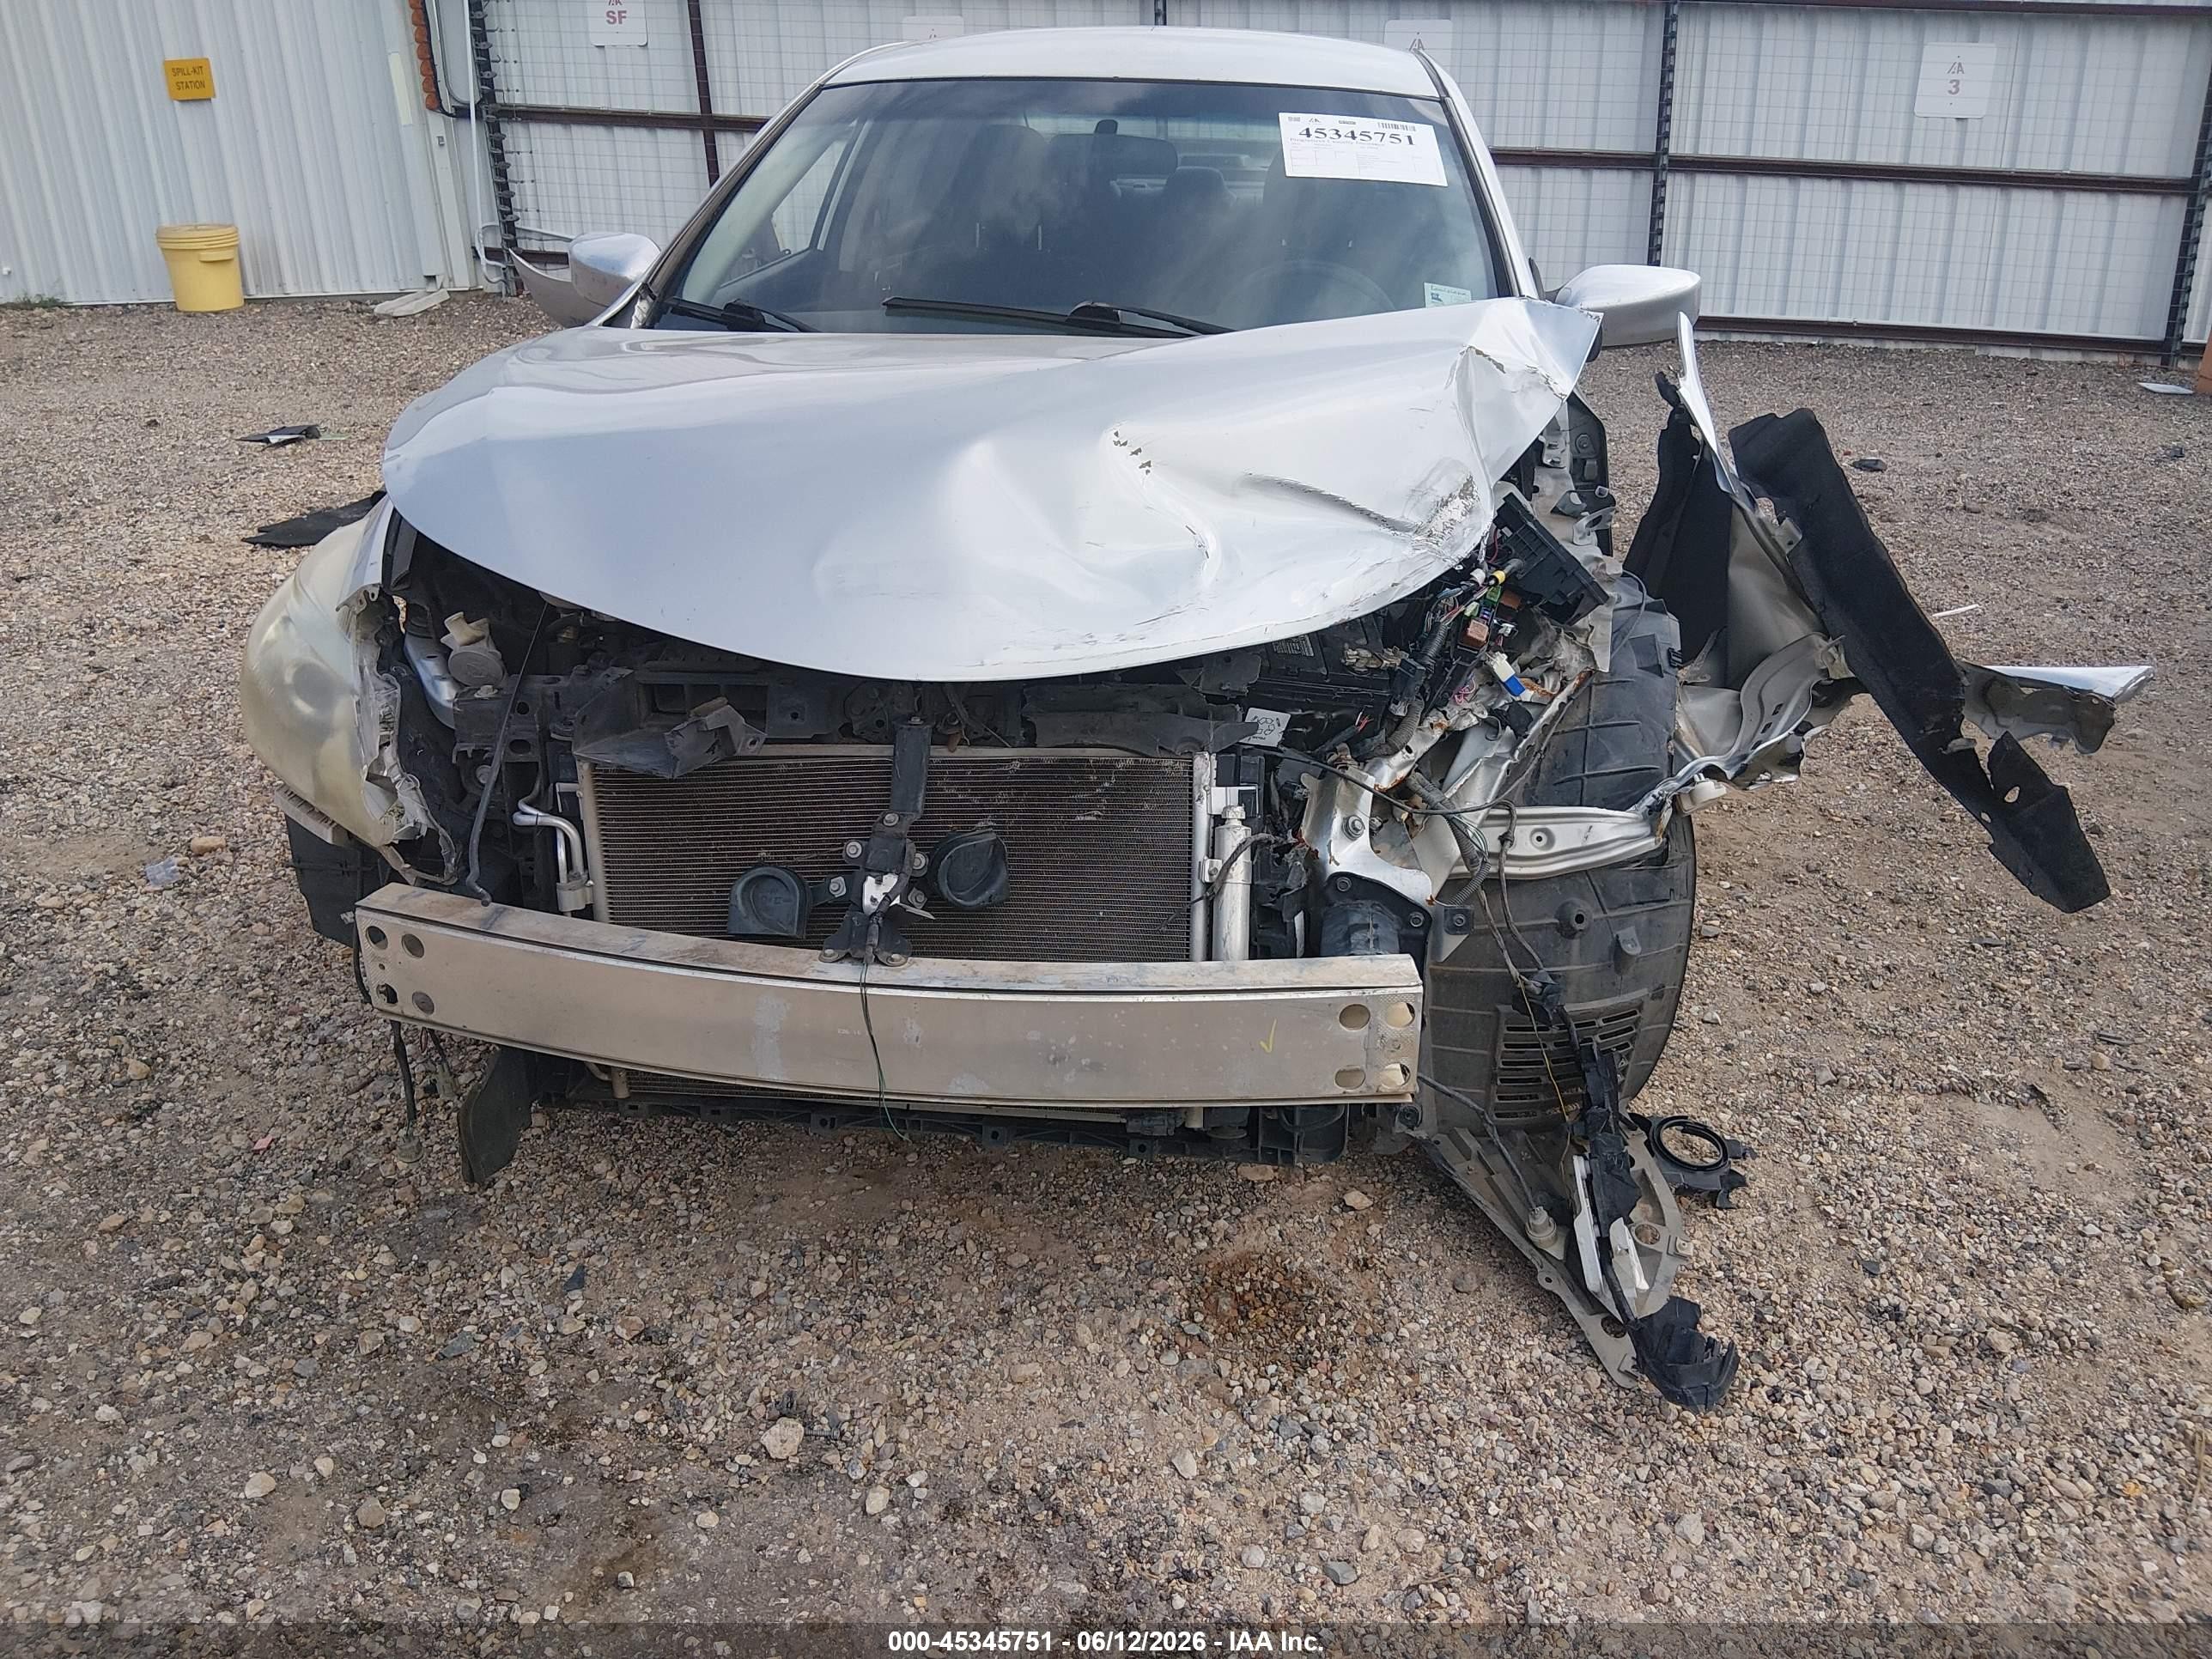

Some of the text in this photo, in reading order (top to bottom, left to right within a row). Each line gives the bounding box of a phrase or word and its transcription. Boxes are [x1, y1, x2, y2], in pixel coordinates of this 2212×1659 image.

[605, 9, 628, 25] SF
[171, 65, 204, 77] SPILL-KIT
[175, 79, 206, 91] STATION
[1947, 79, 1960, 95] 3
[1298, 127, 1417, 146] 45345751
